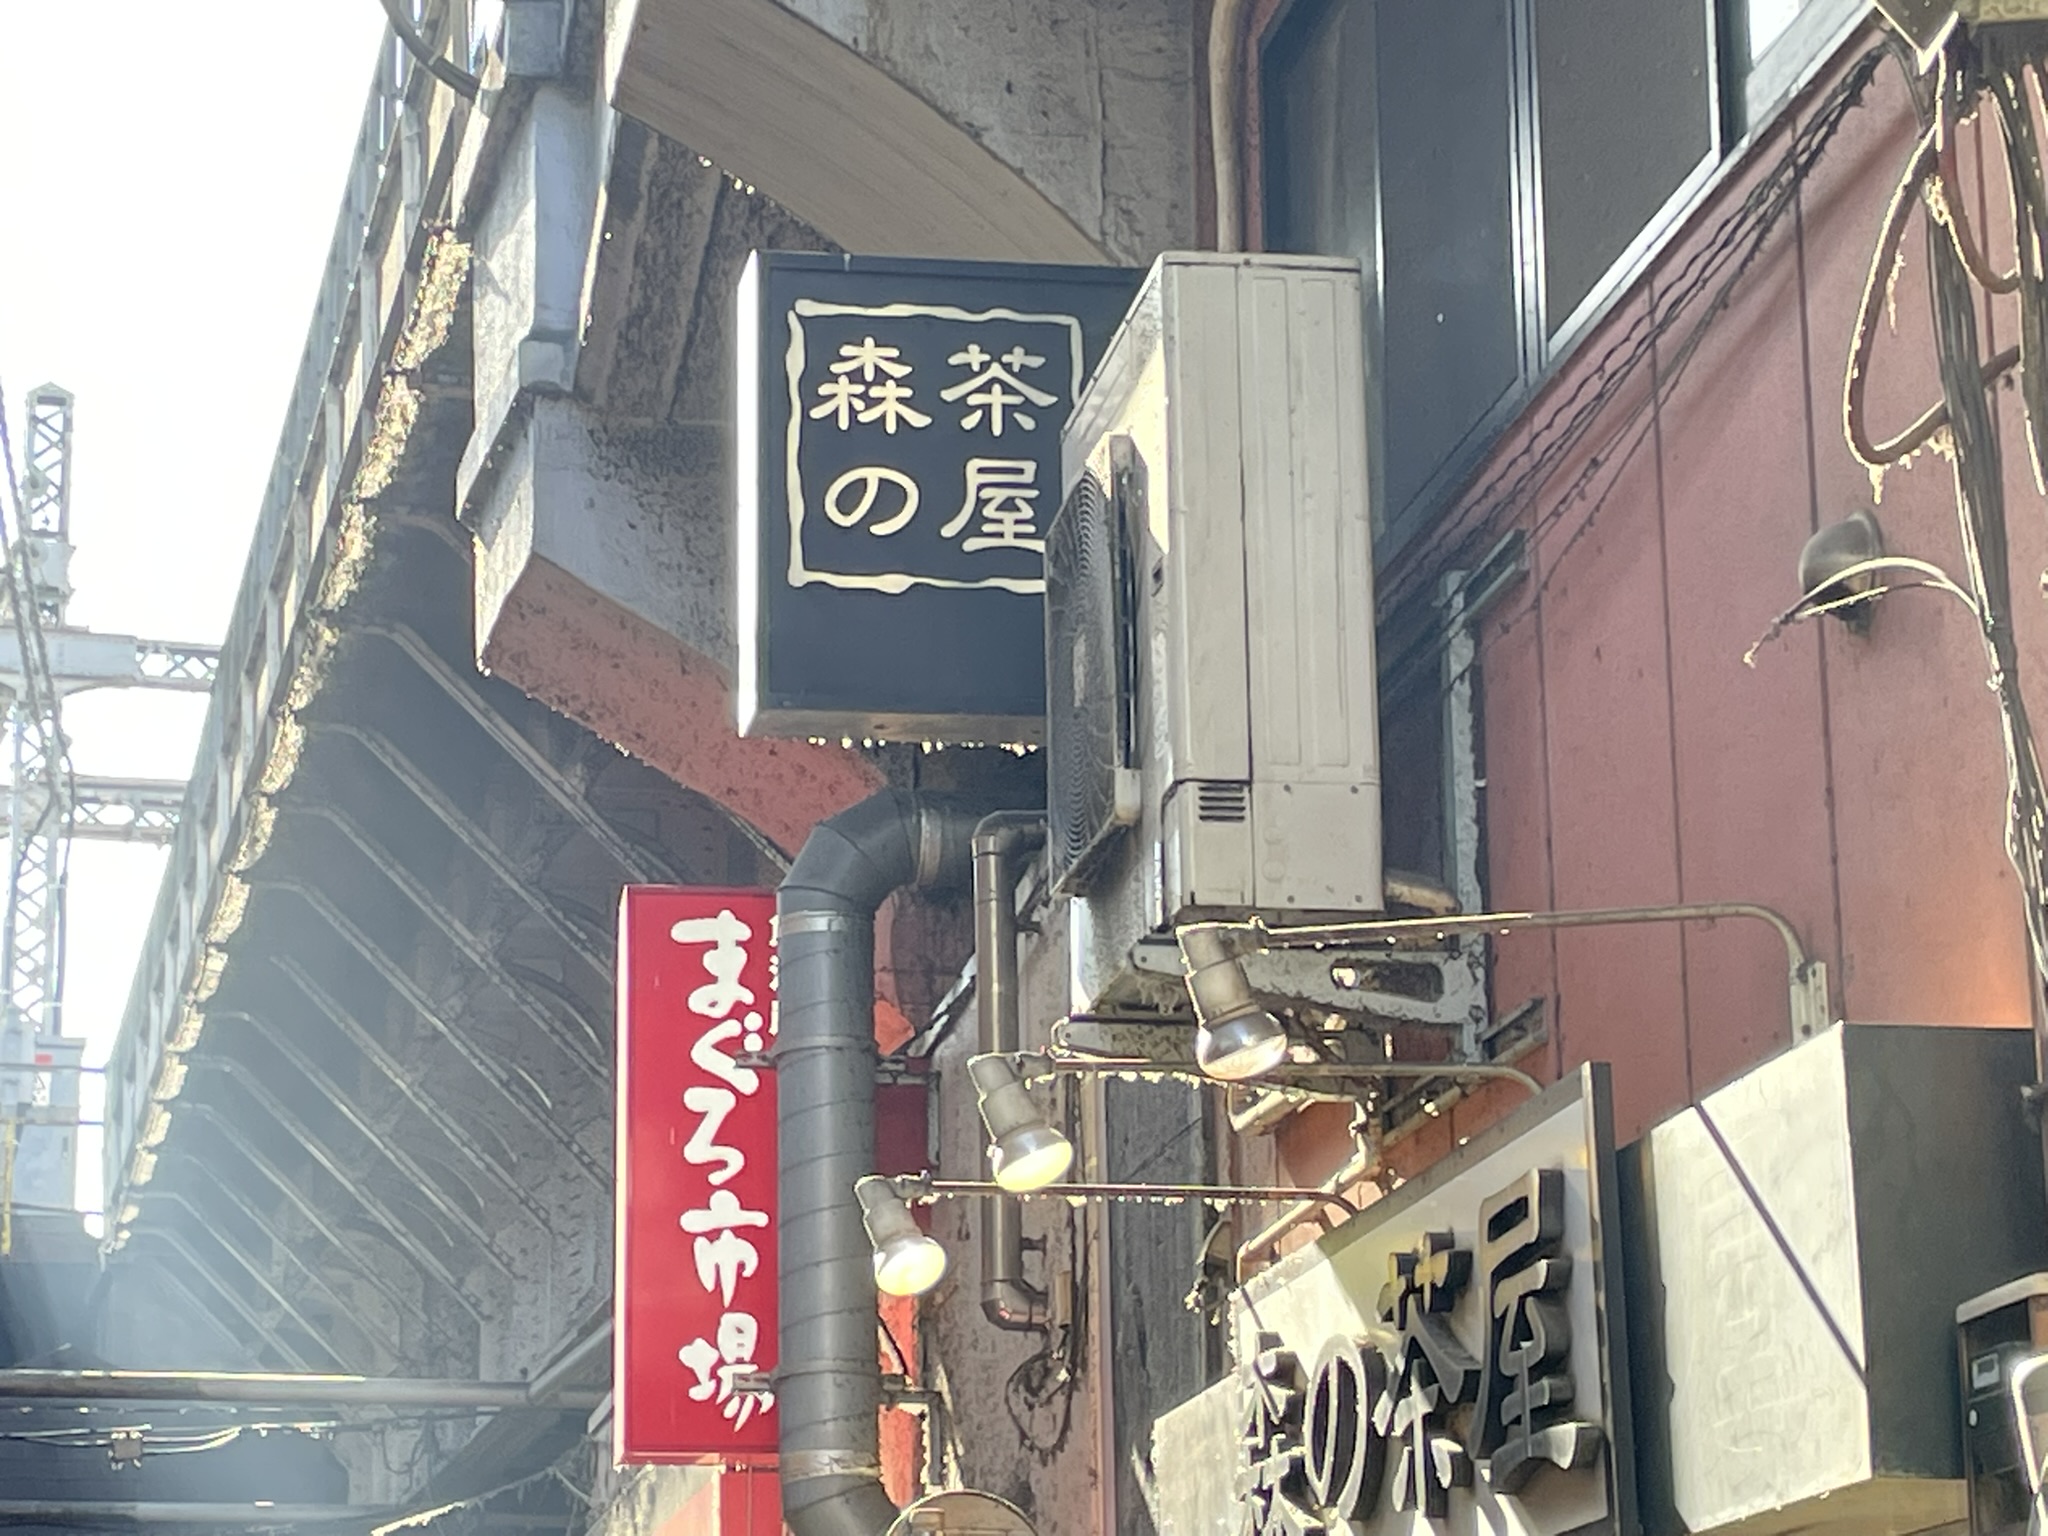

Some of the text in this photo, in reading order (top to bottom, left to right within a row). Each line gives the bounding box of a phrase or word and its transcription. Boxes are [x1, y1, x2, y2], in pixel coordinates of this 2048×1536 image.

[809, 336, 932, 536] 森の
[670, 909, 775, 1432] まぐろ市場
